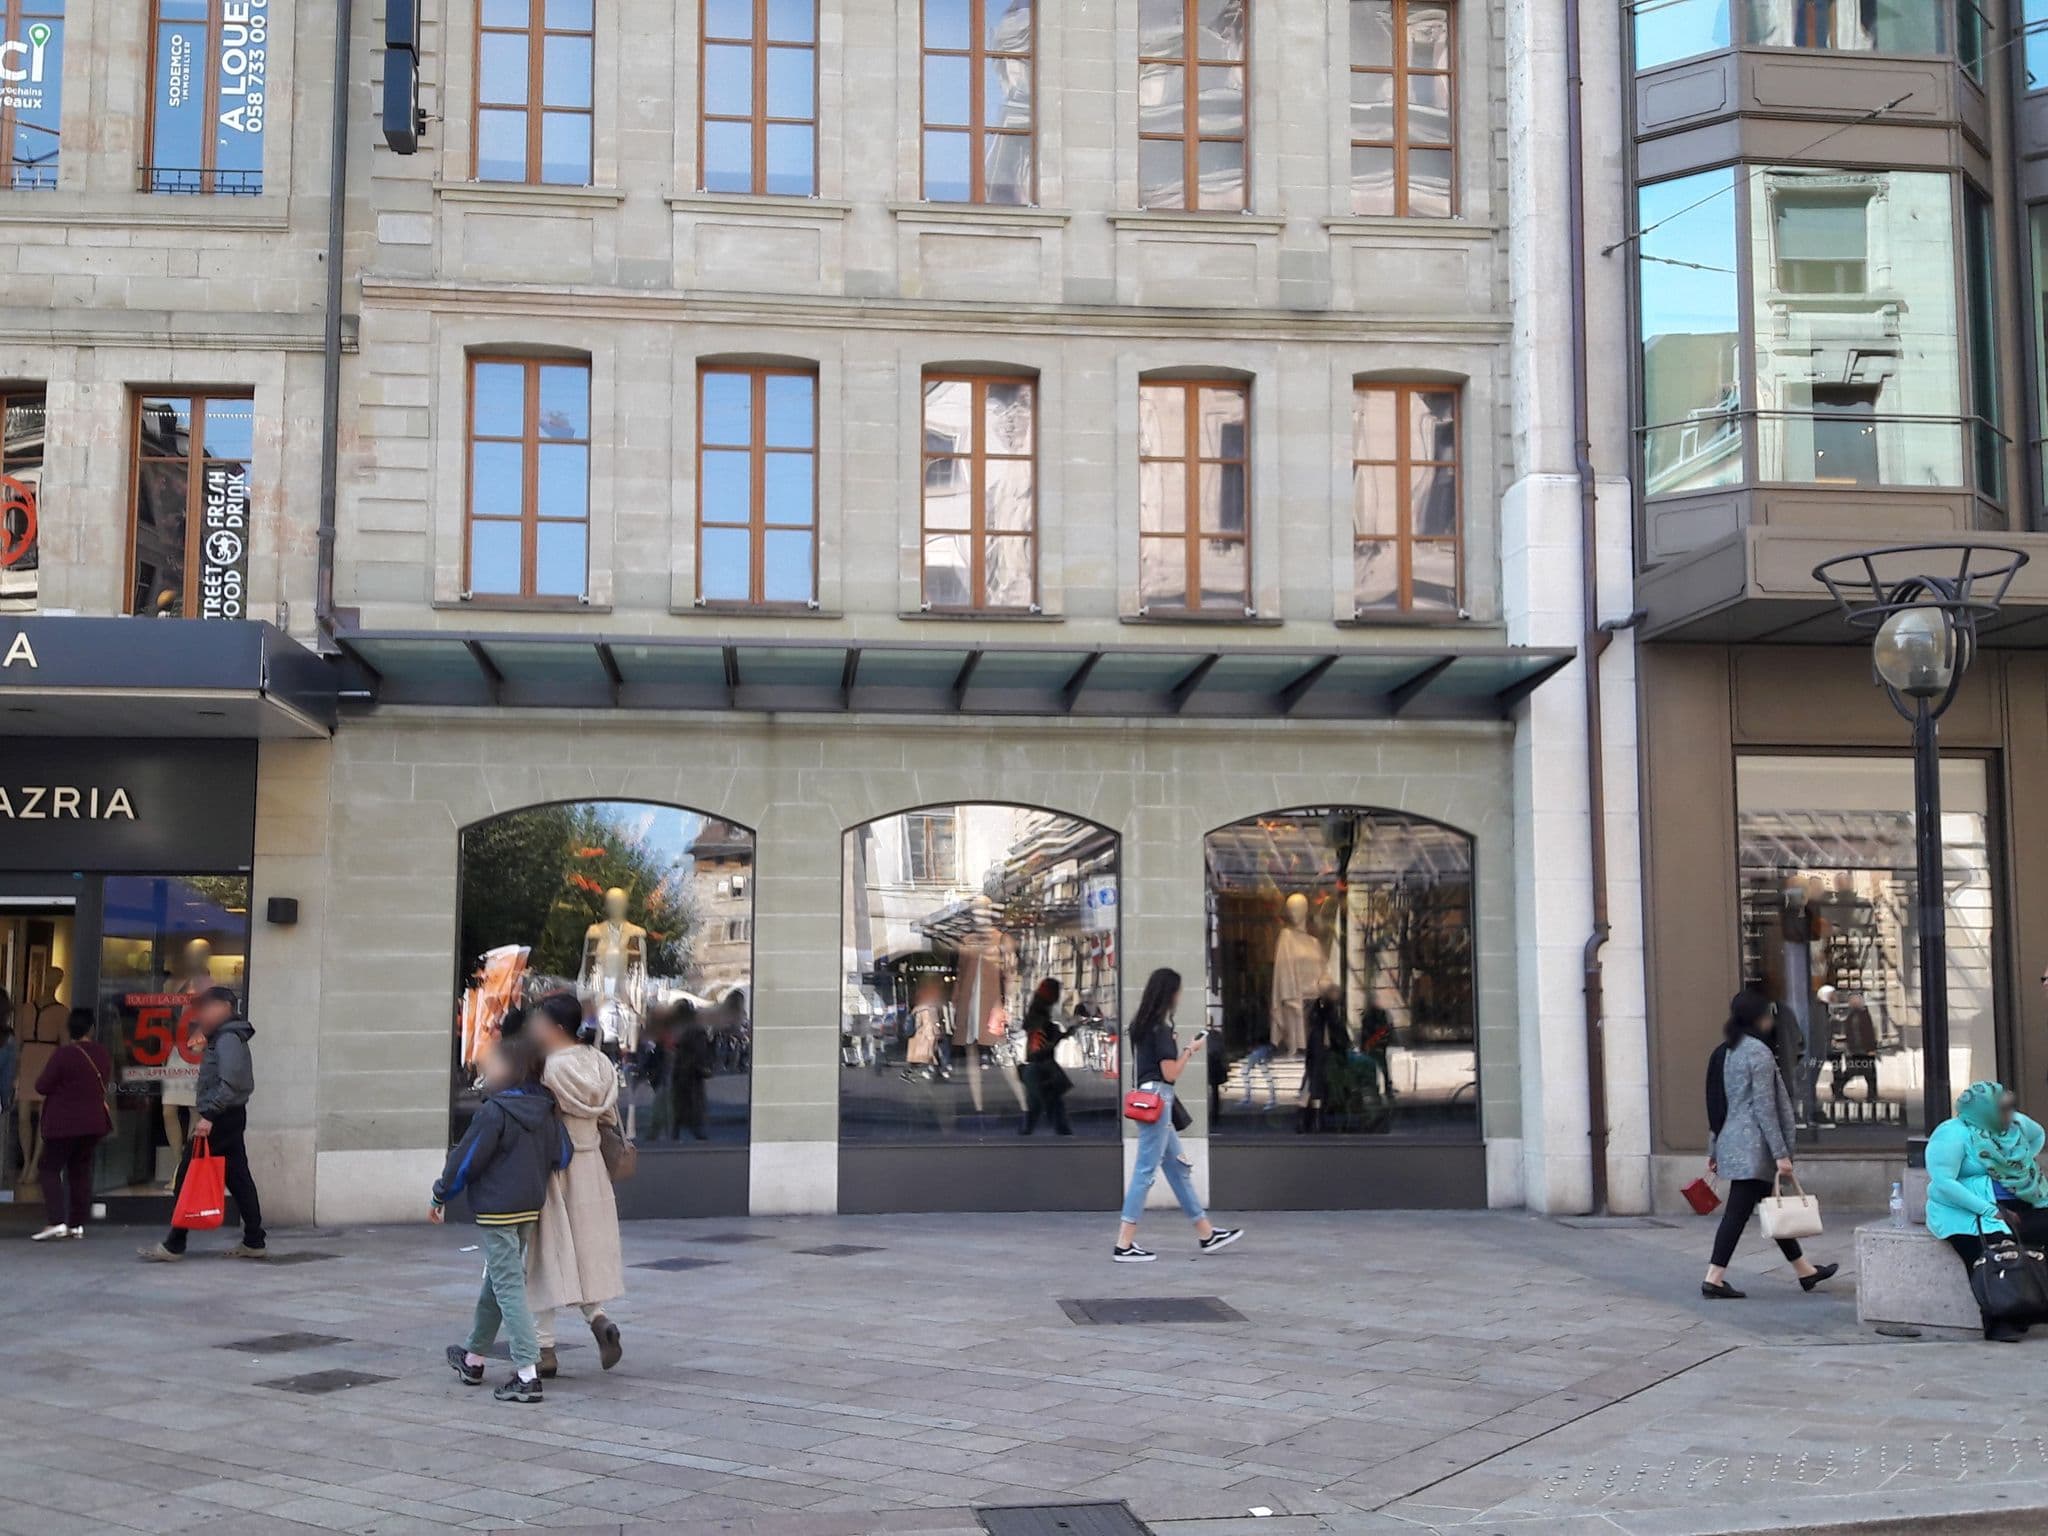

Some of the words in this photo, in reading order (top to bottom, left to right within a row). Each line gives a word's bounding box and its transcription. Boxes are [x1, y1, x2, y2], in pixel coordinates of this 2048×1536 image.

[221, 2, 249, 94] LOUE
[250, 15, 266, 43] 00
[169, 34, 183, 108] SODEMCO
[182, 42, 191, 100] IMMOBILIER
[247, 49, 265, 86] 733
[0, 86, 43, 97] rochains
[246, 92, 264, 133] 058
[220, 106, 246, 132] A
[207, 471, 226, 528] FRESH
[226, 473, 245, 528] DRINK
[223, 570, 241, 620] OOD
[0, 786, 135, 820] AZRIA
